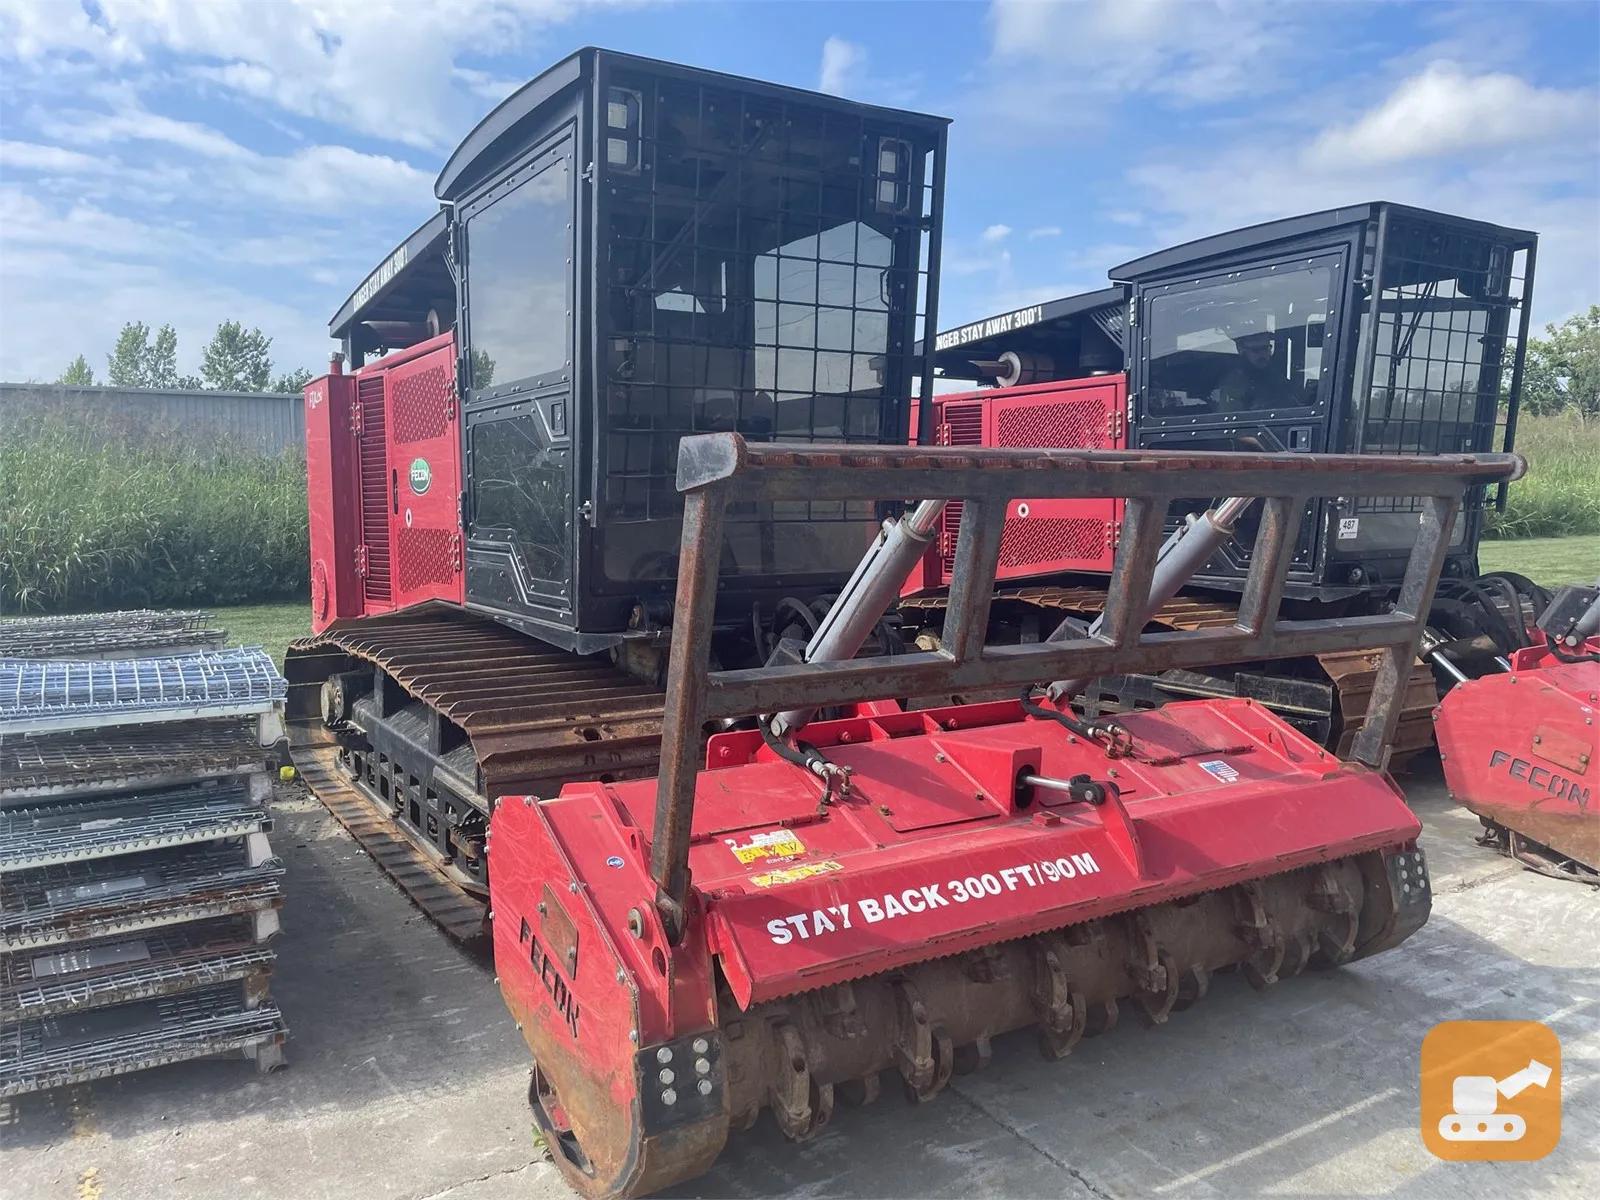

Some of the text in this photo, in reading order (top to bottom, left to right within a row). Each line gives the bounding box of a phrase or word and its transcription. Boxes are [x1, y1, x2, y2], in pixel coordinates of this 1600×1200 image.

[935, 331, 959, 351] NGER
[961, 322, 985, 343] STAY
[985, 313, 1013, 337] AWAY
[1342, 520, 1355, 530] 487
[1489, 750, 1590, 809] FECON
[766, 902, 851, 945] STAY
[858, 883, 949, 924] BACK
[948, 872, 1001, 903] 300
[519, 915, 579, 1039] FECON
